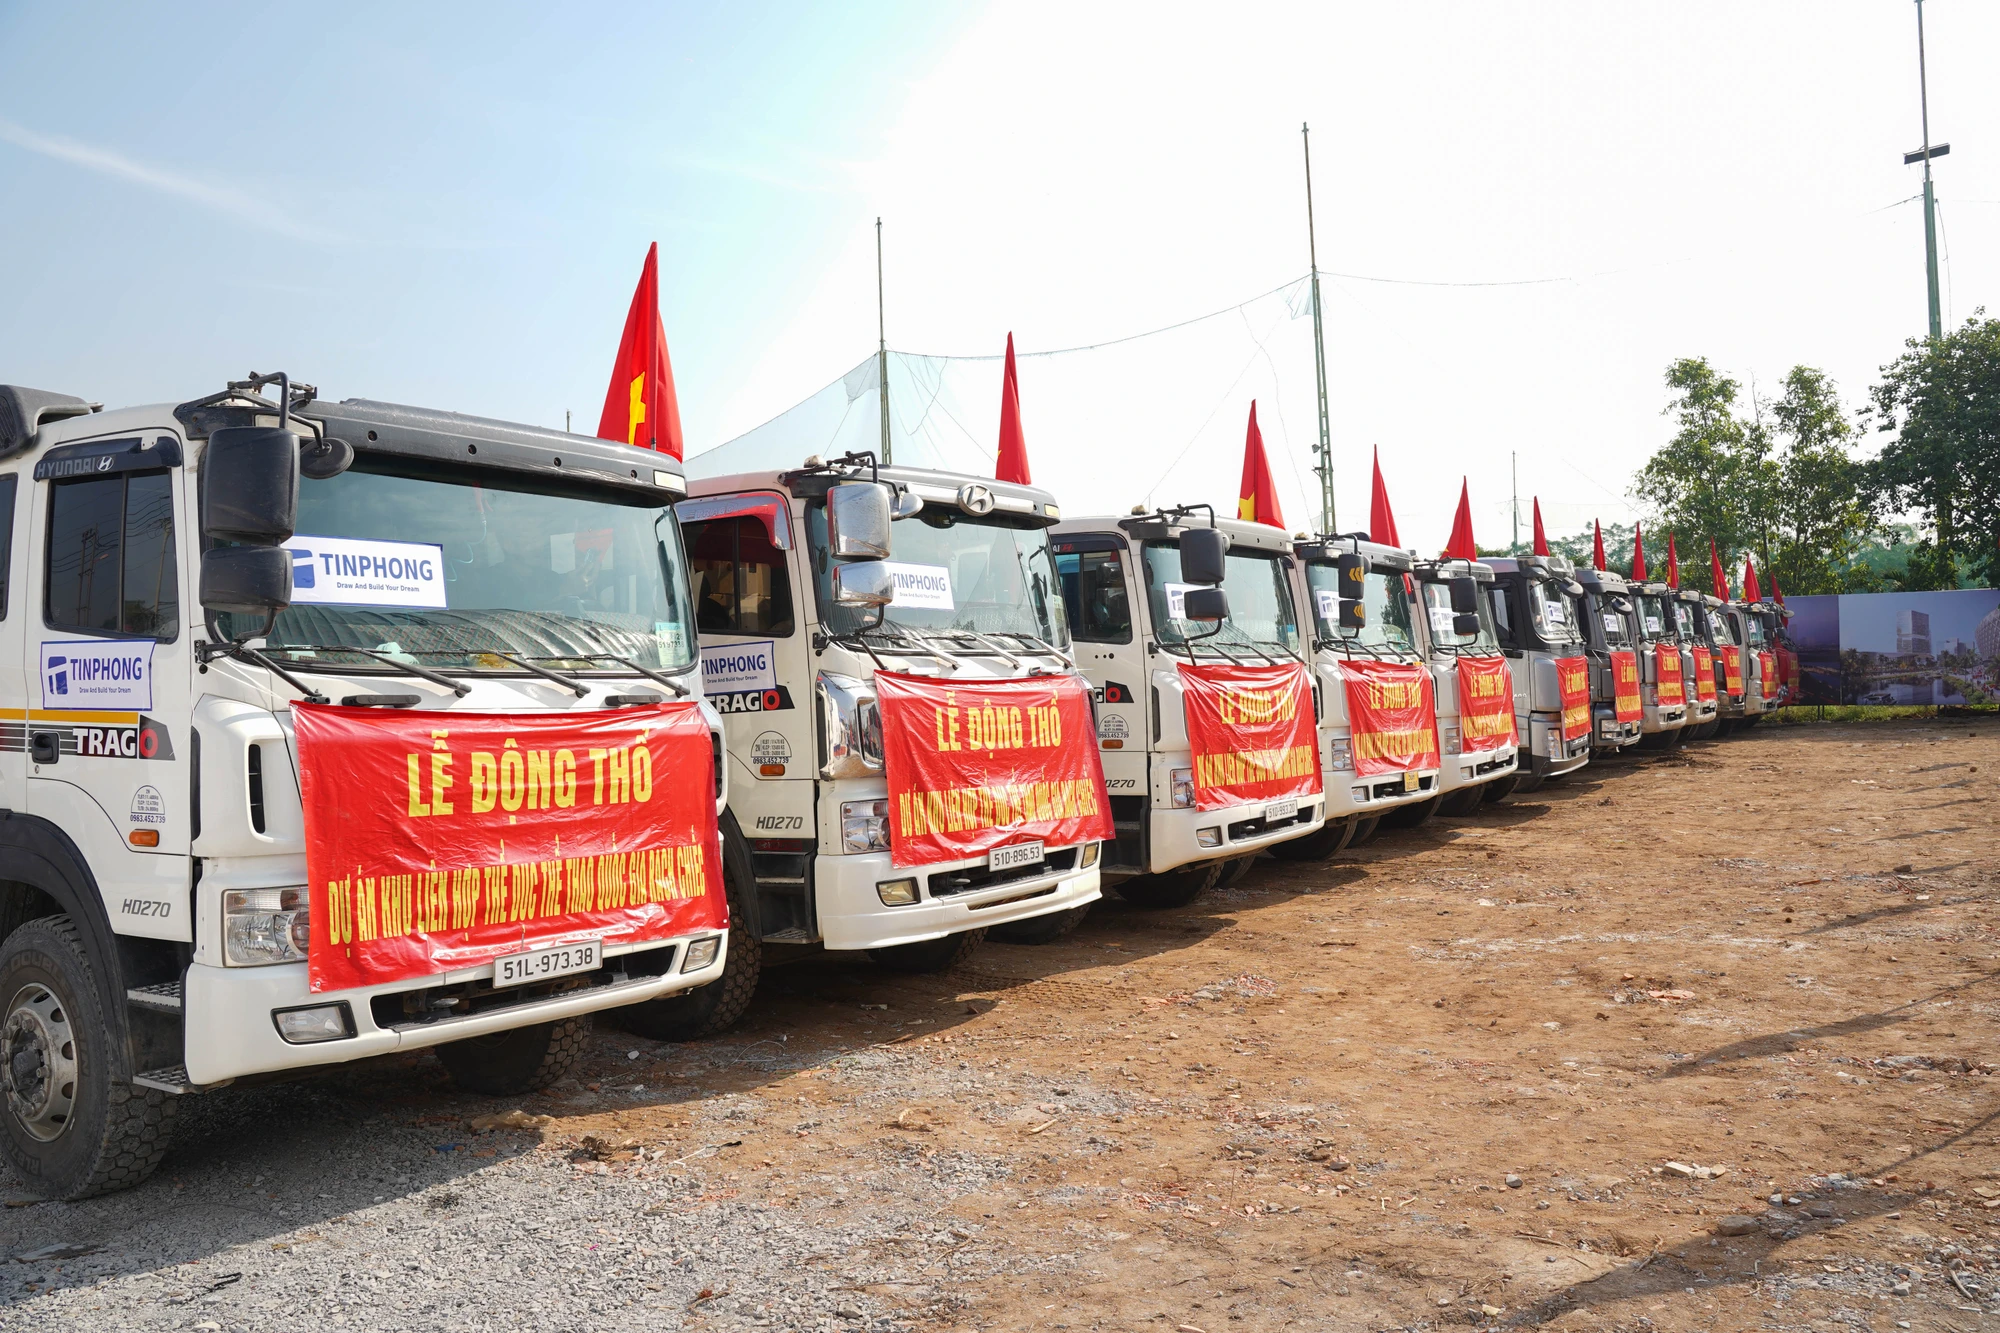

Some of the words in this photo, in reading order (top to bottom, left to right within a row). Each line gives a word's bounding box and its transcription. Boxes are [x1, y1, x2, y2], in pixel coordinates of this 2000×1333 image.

[37, 458, 95, 478] HYUNDAI
[319, 553, 433, 581] TINPHONG
[355, 582, 368, 590] And
[368, 583, 384, 591] Build
[385, 584, 400, 592] Your
[70, 656, 142, 680] TINPHONG
[79, 686, 89, 694] Draw
[89, 686, 97, 694] And
[98, 686, 108, 694] Build
[708, 690, 780, 713] RAGO
[936, 691, 962, 752] LỄ
[968, 698, 1023, 759] ĐỘNG
[1027, 690, 1062, 748] THỔ
[72, 728, 158, 758] TRAGO
[753, 757, 789, 765] 0983.452.739
[407, 729, 454, 818] LỄ
[470, 738, 576, 824] ĐỘNG
[588, 728, 652, 806] THỔ
[130, 815, 166, 823] 0983.452.739
[756, 816, 803, 829] HD270
[994, 846, 1040, 866] 51D-896.53
[328, 874, 352, 958] DỰ
[357, 865, 378, 942] ÁN
[381, 874, 412, 938] KHU
[417, 860, 448, 934] LIÊN
[452, 863, 480, 942] HỢP
[565, 856, 595, 915] THAO
[597, 832, 626, 914] QUỐC
[629, 851, 647, 906] GIA
[122, 898, 171, 918] HD270
[504, 947, 593, 980] 51L-973.38
